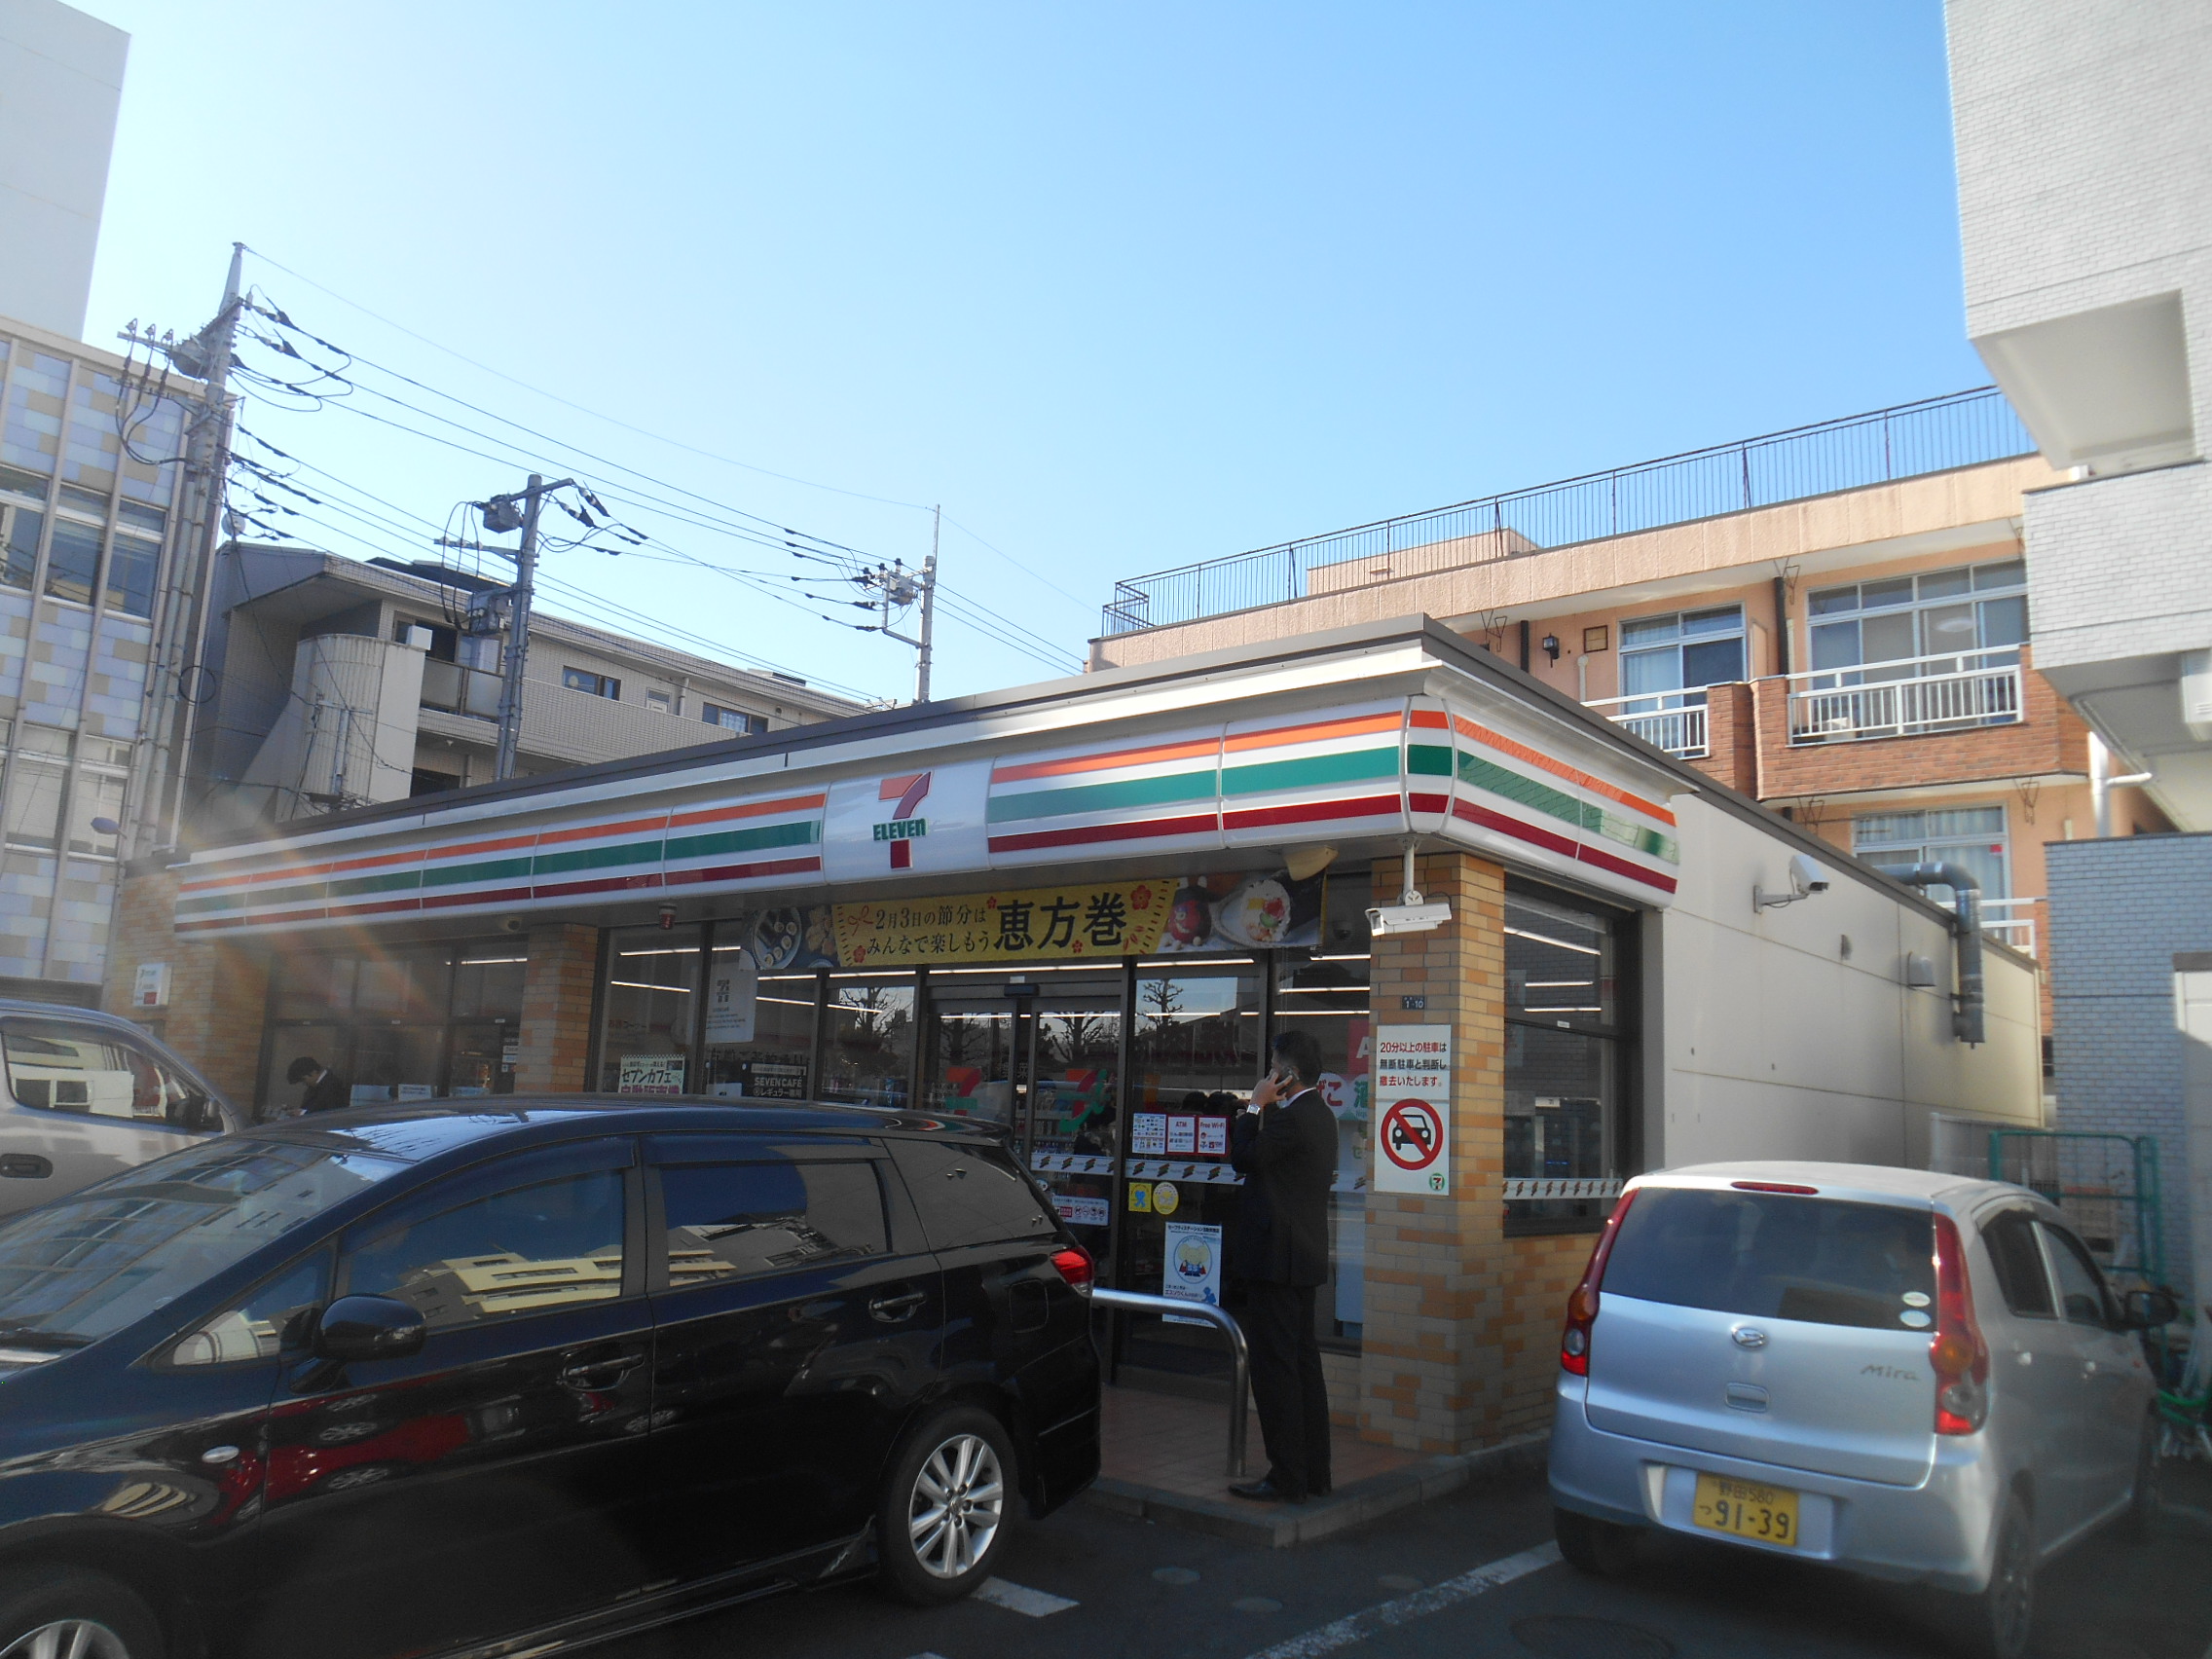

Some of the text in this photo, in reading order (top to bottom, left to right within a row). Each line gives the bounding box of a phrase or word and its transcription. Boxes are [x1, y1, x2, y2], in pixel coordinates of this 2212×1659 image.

[875, 904, 986, 931] 2月3日の節分は
[993, 892, 1127, 951] 恵方巻
[866, 931, 990, 955] みんなで楽しもう
[1380, 1042, 1447, 1053] 20分以上の駐車は
[1380, 1058, 1447, 1070] 無断駐車と判断し
[622, 1069, 672, 1084] セブンカフェ
[755, 1078, 782, 1088] SEVEN
[1860, 1364, 1920, 1381] Mira
[1714, 1500, 1789, 1539] 91-39
